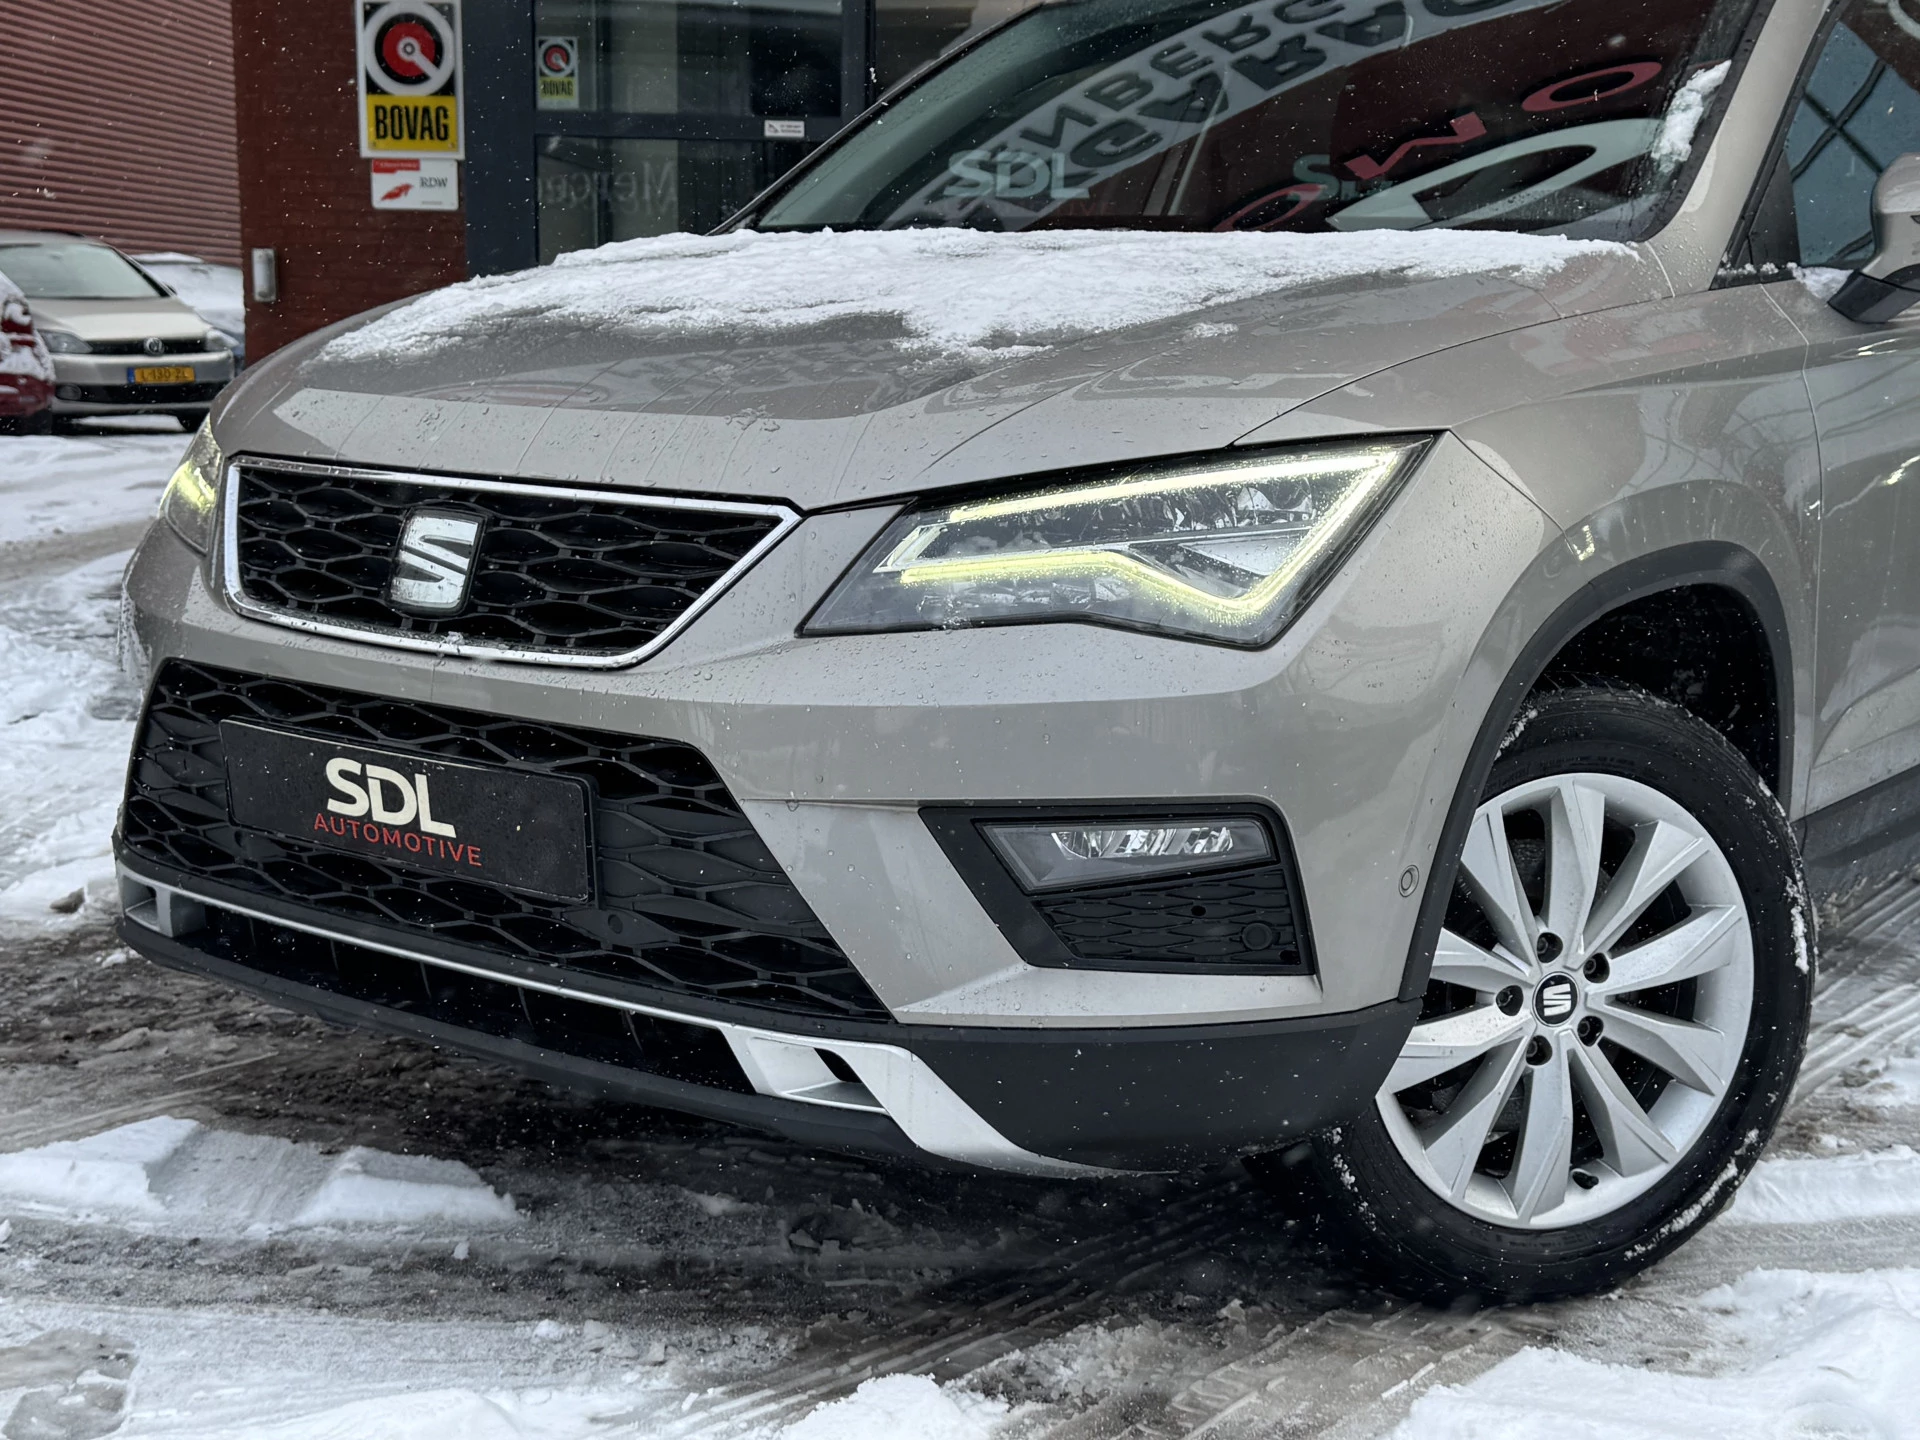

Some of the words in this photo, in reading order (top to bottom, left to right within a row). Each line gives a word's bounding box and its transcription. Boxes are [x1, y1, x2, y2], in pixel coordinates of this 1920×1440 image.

[541, 79, 574, 97] BOVAG
[375, 105, 449, 140] BOVAG
[419, 176, 448, 189] RDW
[325, 757, 457, 839] SDL
[313, 812, 483, 867] AUTOMOTIVE
